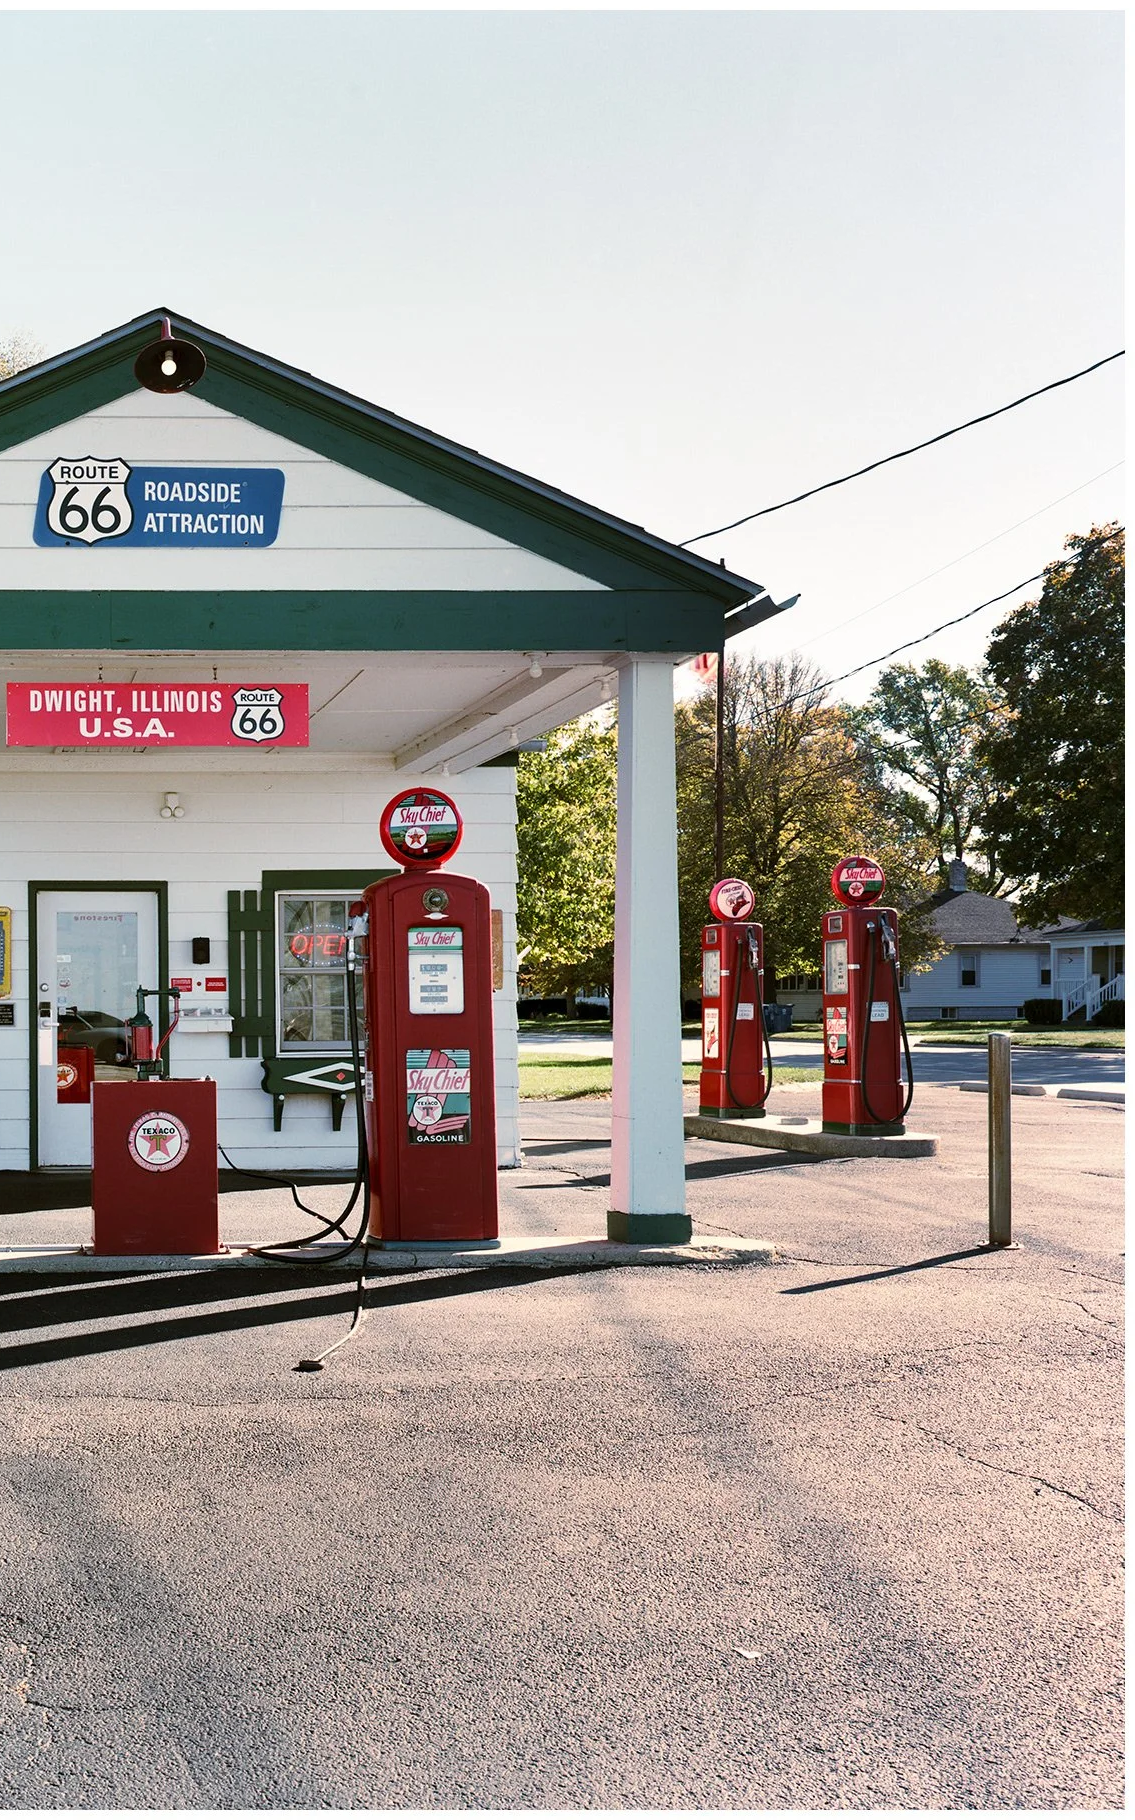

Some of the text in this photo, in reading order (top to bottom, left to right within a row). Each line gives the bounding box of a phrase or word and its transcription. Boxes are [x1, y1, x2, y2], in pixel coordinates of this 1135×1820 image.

[60, 466, 119, 479] ROUTE
[144, 481, 241, 503] ROADSIDE
[59, 486, 121, 534] 66
[143, 512, 264, 535] ATTRACTION
[29, 690, 222, 714] DWIGHT, ILLINOIS
[240, 693, 275, 703] ROUTE
[79, 718, 175, 738] U.S.A.
[239, 708, 277, 731] 66
[400, 806, 447, 824] Sky Chief
[414, 931, 456, 947] Sky Chief
[406, 1069, 470, 1094] Sky Chief
[142, 1127, 176, 1135] TEXACO
[416, 1134, 464, 1143] GASOLINE
